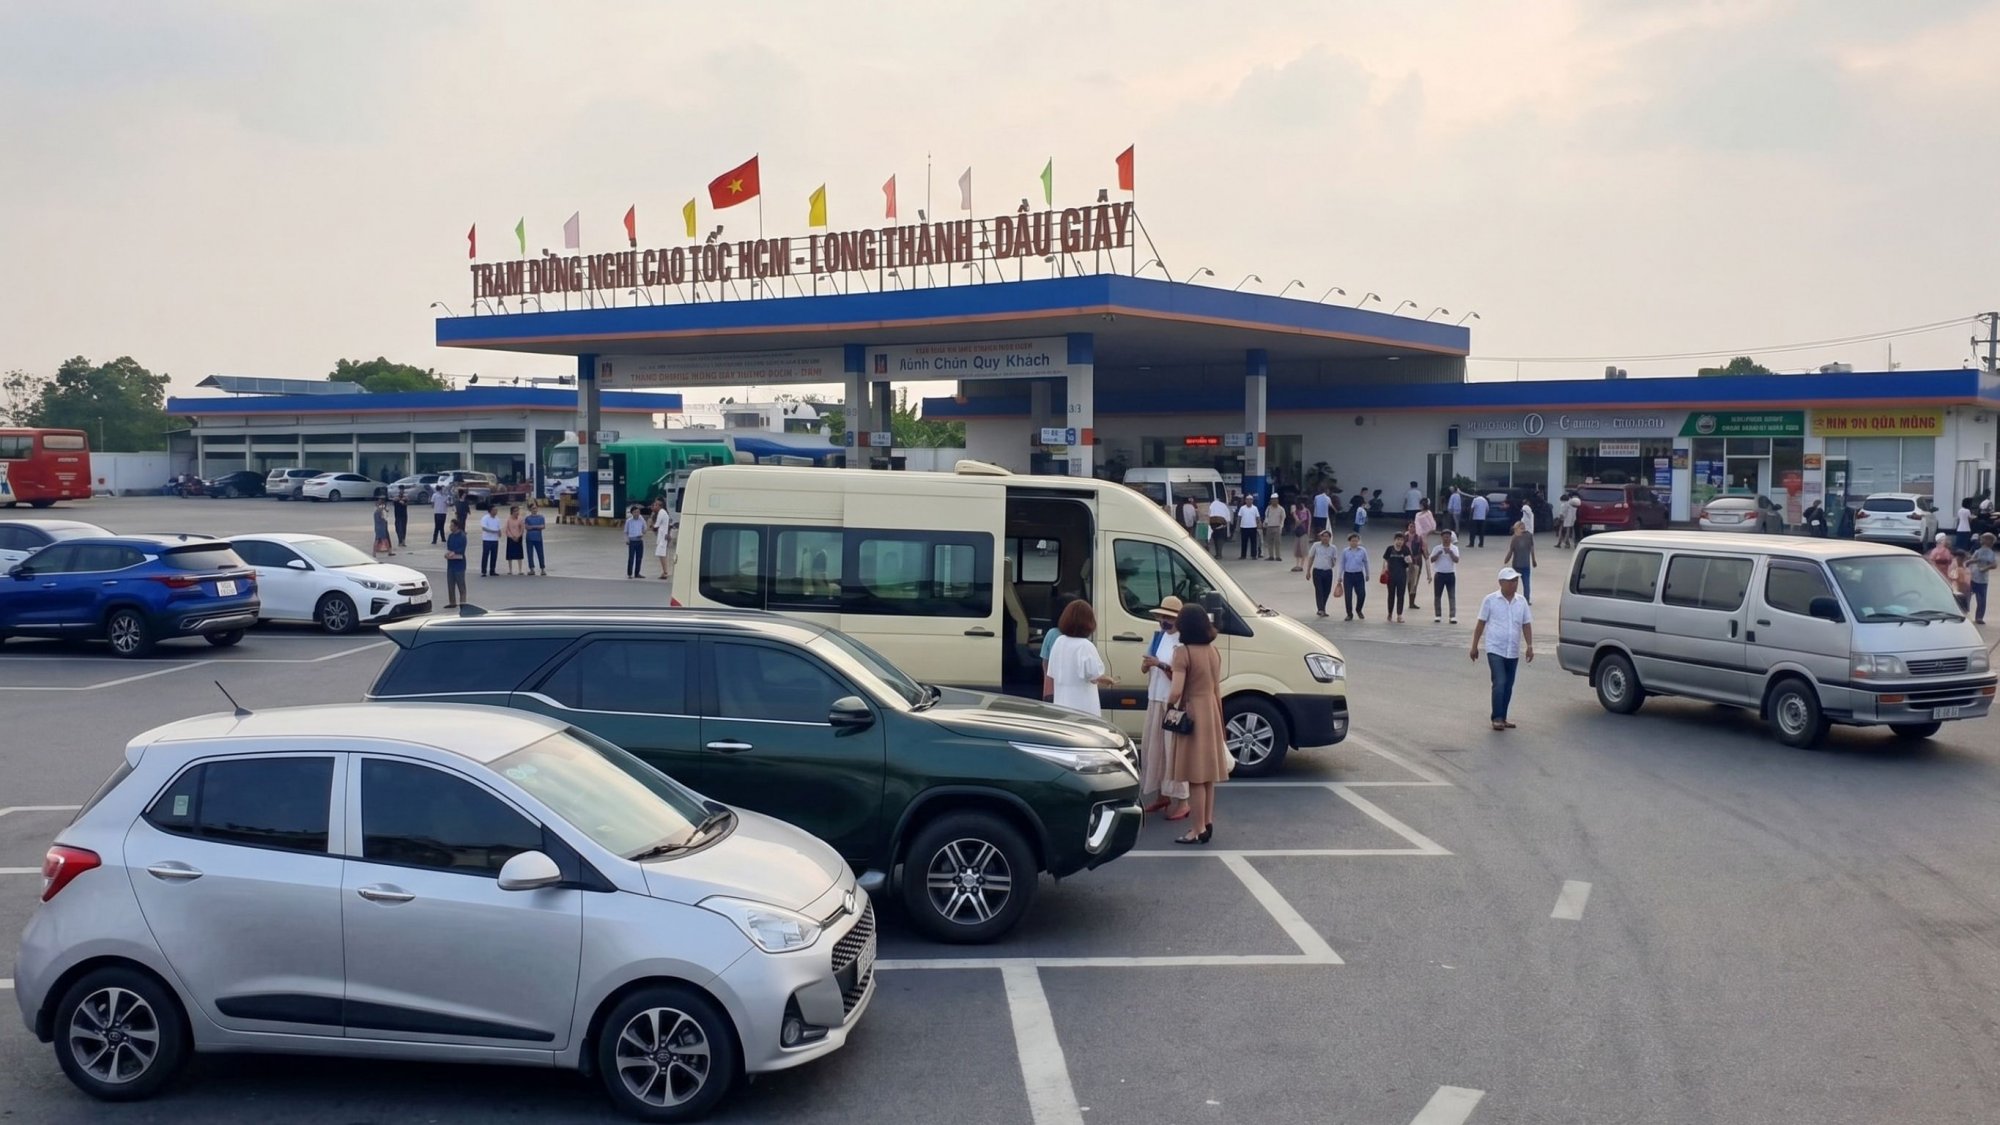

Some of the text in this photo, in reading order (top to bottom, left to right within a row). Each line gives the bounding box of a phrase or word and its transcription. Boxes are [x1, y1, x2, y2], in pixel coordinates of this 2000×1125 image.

[529, 248, 582, 293] DỪNG
[642, 249, 685, 287] CAO
[689, 225, 733, 284] TỐC
[738, 237, 791, 279] HCM
[809, 228, 876, 274] LONG
[882, 209, 973, 268] THÀNH
[995, 198, 1053, 260] DẦU
[1006, 353, 1051, 367] Khách
